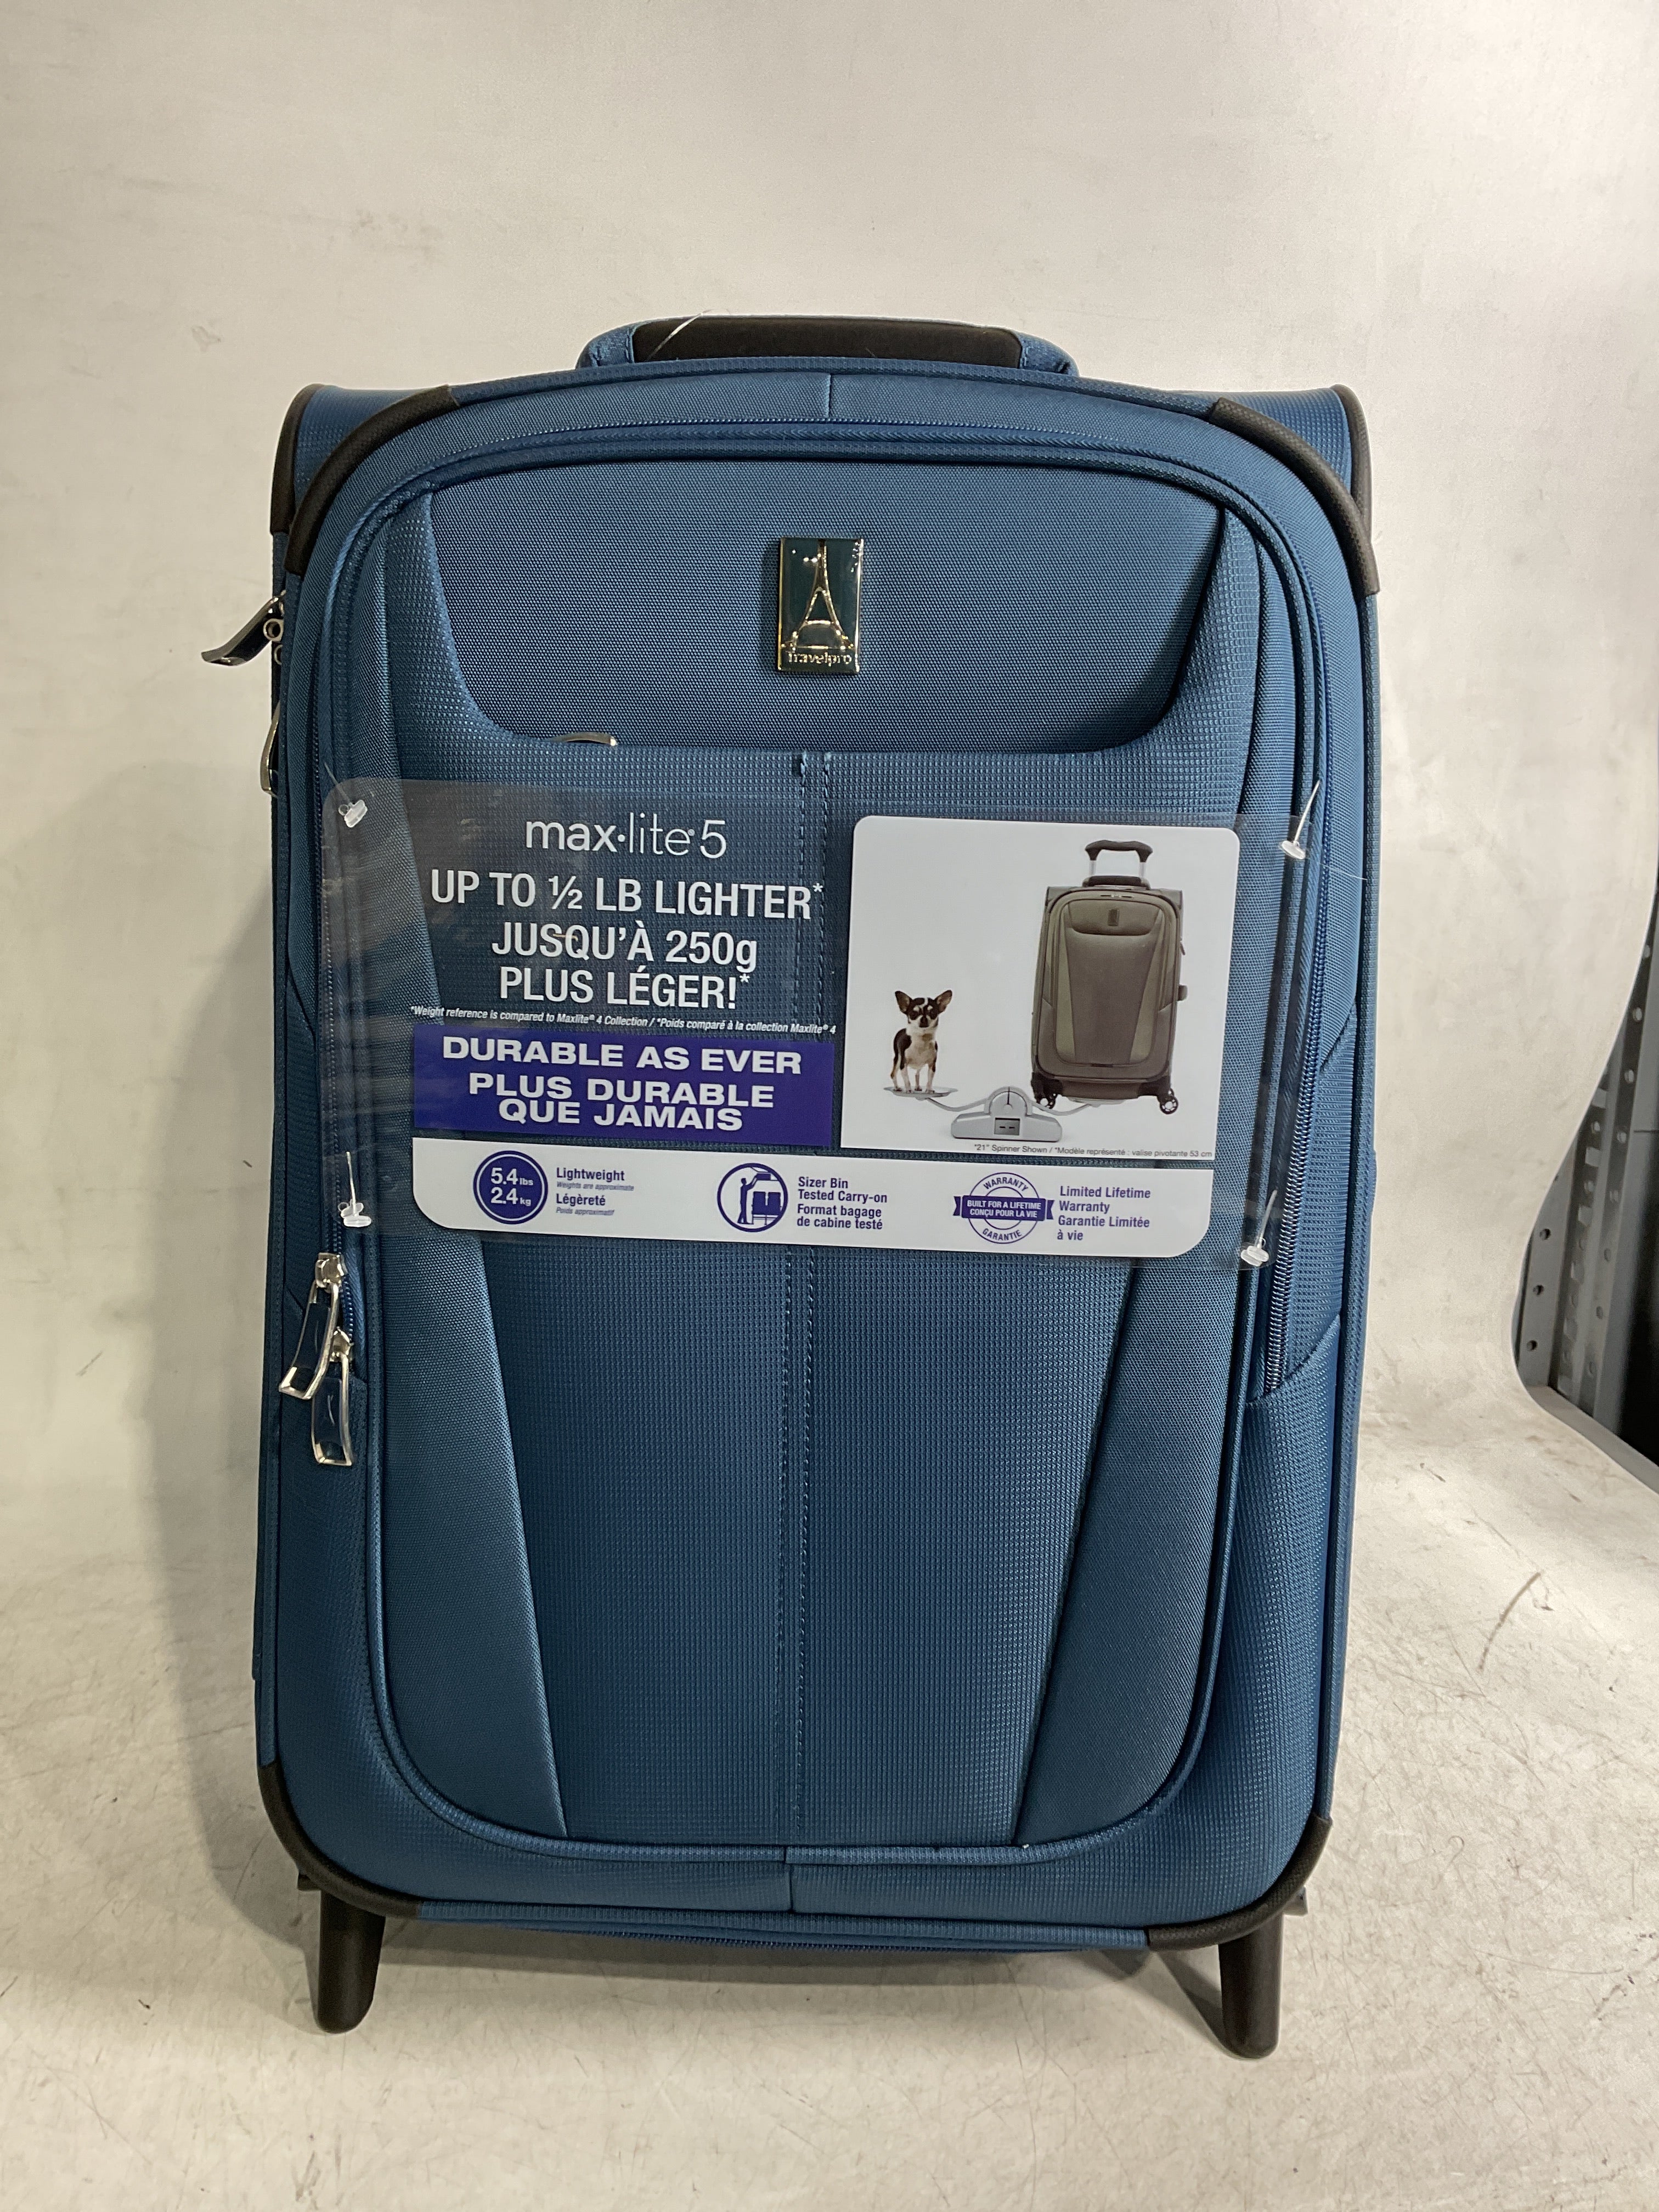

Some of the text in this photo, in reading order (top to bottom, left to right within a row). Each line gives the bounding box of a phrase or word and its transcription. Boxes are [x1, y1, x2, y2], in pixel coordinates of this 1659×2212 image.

[700, 820, 727, 859] 5
[431, 869, 479, 904] UP
[489, 872, 536, 908] TO
[596, 878, 641, 912] LB
[665, 930, 758, 973] 250g
[500, 967, 594, 1005] PLUS
[445, 1009, 487, 1019] reference
[489, 1009, 498, 1019] is
[499, 1011, 544, 1023] compared
[546, 1013, 555, 1023] to
[596, 1015, 603, 1024] 4
[604, 1015, 648, 1028] Collection
[686, 1020, 725, 1031] comparé
[726, 1021, 733, 1031] à
[735, 1022, 744, 1031] la
[746, 1023, 788, 1033] collection
[830, 1025, 836, 1034] 4
[443, 1035, 802, 1075] DURABLE AS EVER
[469, 1072, 775, 1109] PLUS DURABLE
[499, 1098, 743, 1132] QUE JAMAIS
[991, 1144, 1020, 1153] Spinner
[1087, 1148, 1125, 1156] représenté
[1154, 1149, 1188, 1158] pivotante
[556, 1167, 625, 1183] Lightweight
[798, 1176, 849, 1189] Sizer Bin
[556, 1181, 582, 1190] Weights
[595, 1183, 635, 1192] approximate
[983, 1177, 1029, 1192] WARRANTY
[1059, 1185, 1151, 1199] Limited Lifetime
[555, 1193, 606, 1207] Légèreté
[798, 1189, 888, 1204] Tested Carry-on
[574, 1208, 615, 1216] approximatif
[797, 1204, 882, 1219] Format bagage
[969, 1208, 994, 1217] CONÇU
[1009, 1201, 1042, 1210] LIFETIME
[1059, 1200, 1110, 1214] Warranty
[797, 1216, 883, 1231] de cabine testé
[1058, 1216, 1150, 1228] Garantie Limitée
[983, 1228, 1023, 1242] GARANTIE
[1057, 1229, 1084, 1242] à vie
